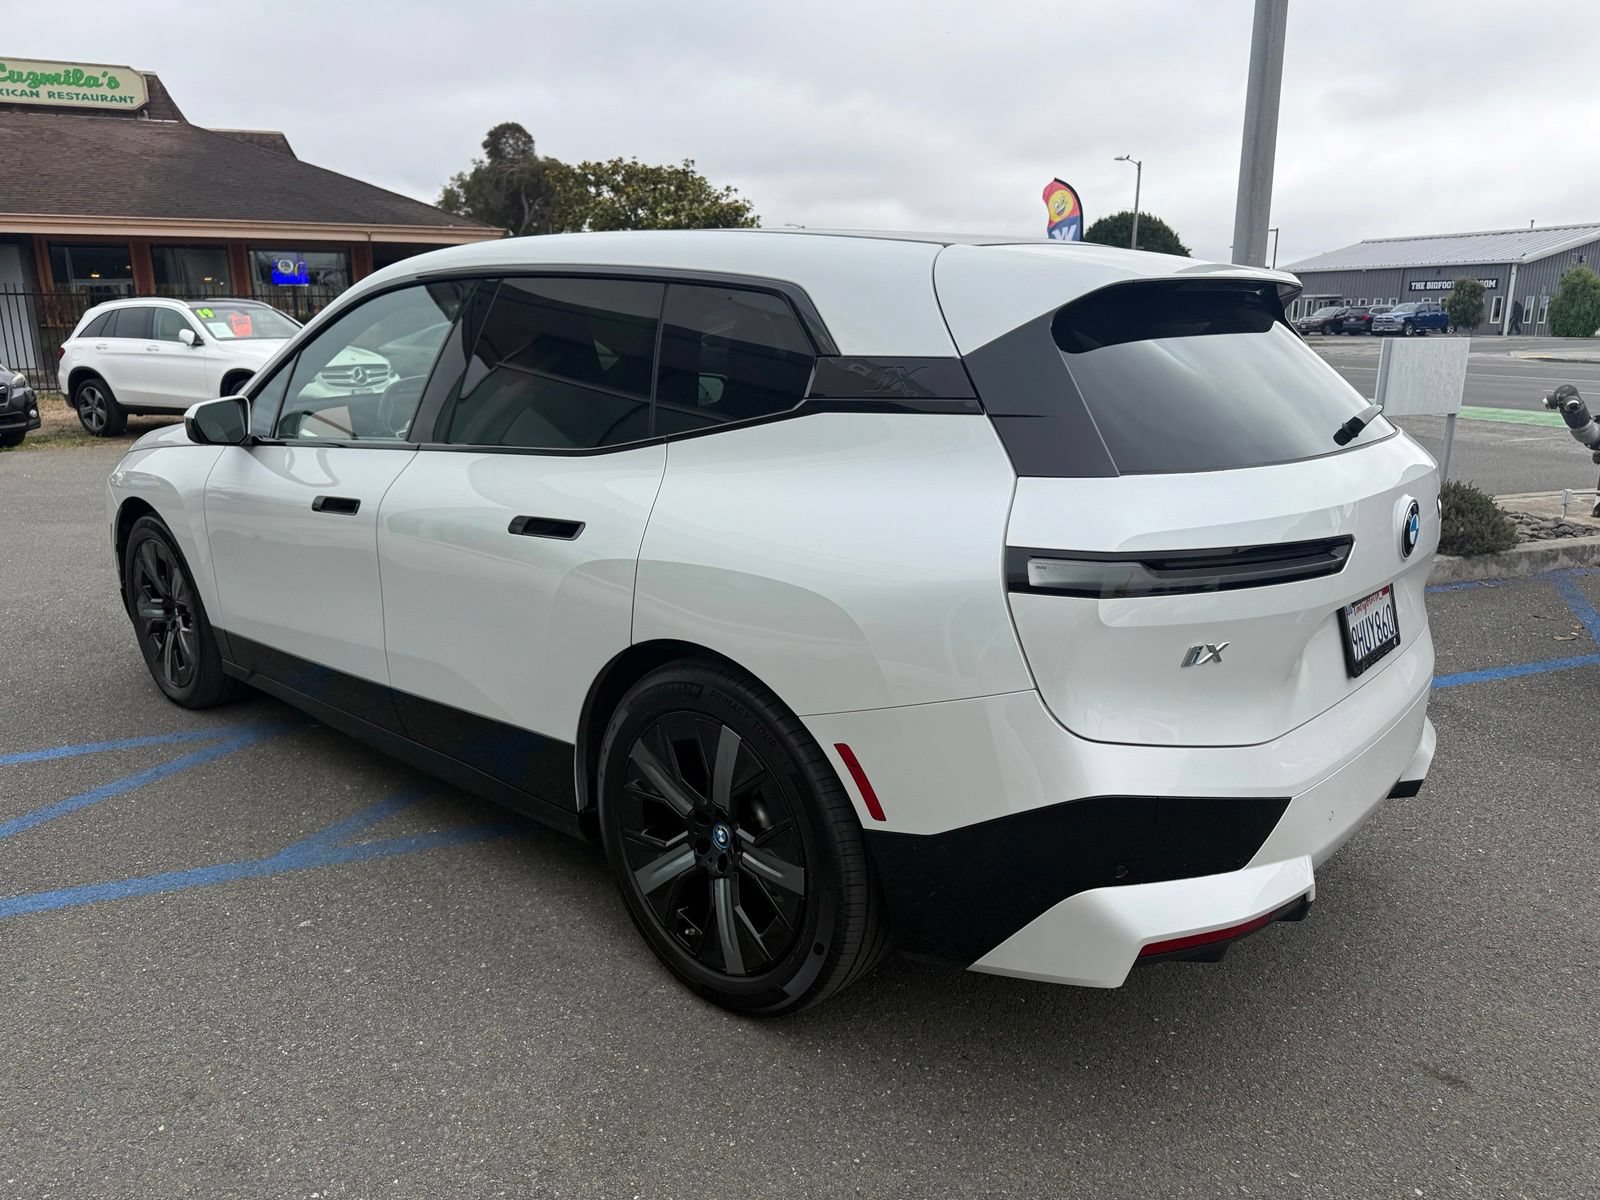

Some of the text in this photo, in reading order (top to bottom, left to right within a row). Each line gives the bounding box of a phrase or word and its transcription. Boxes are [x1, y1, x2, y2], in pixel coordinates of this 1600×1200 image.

[47, 91, 135, 103] RESTAURANT
[1411, 282, 1424, 290] THE
[1351, 603, 1395, 661] 9HUY860
[710, 689, 753, 720] PRIMACY
[752, 720, 777, 749] TOUR
